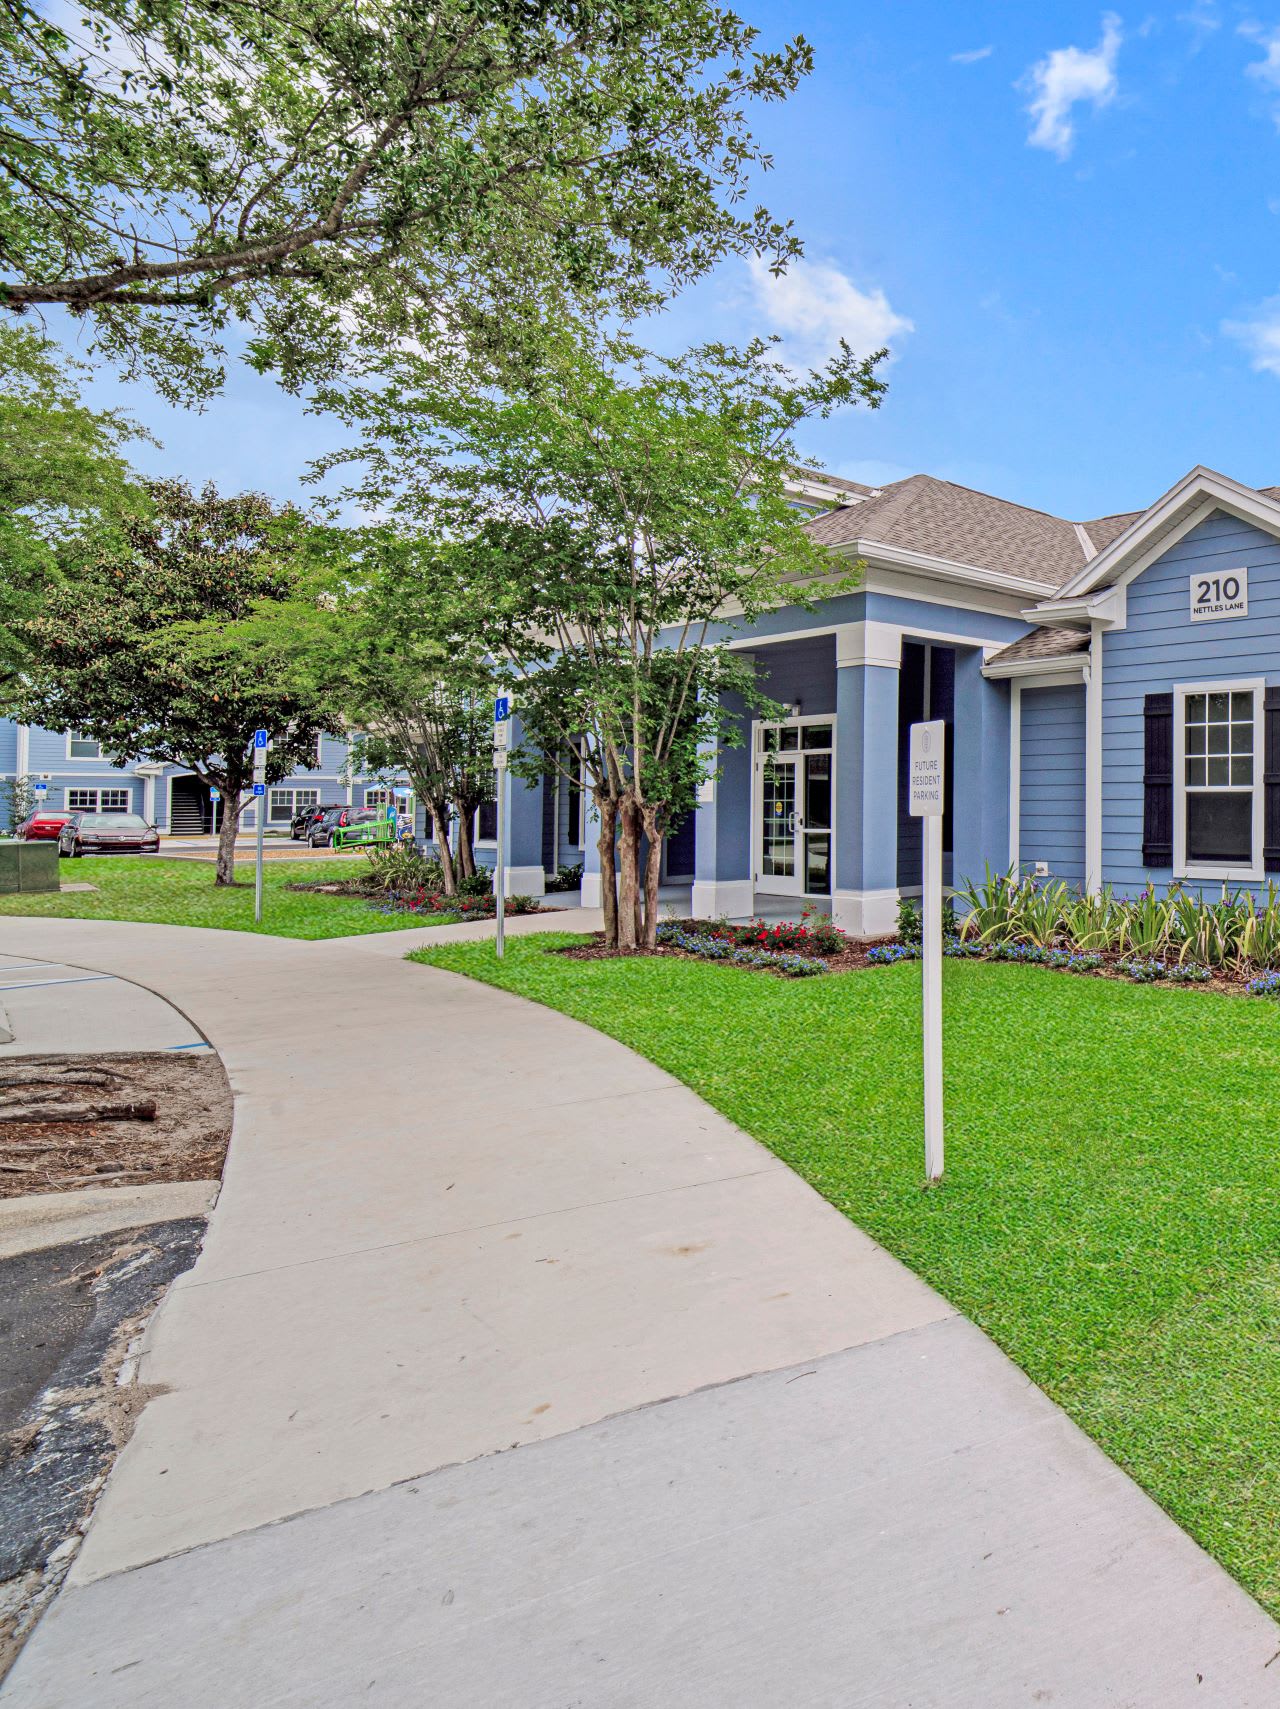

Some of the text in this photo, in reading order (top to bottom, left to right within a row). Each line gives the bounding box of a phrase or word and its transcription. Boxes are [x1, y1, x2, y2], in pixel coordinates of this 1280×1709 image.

[1197, 577, 1239, 603] 210
[1193, 602, 1244, 614] NETTLES LANE
[915, 760, 938, 770] FUTURE
[912, 775, 940, 785] RESIDENT
[913, 790, 939, 800] PARKING
